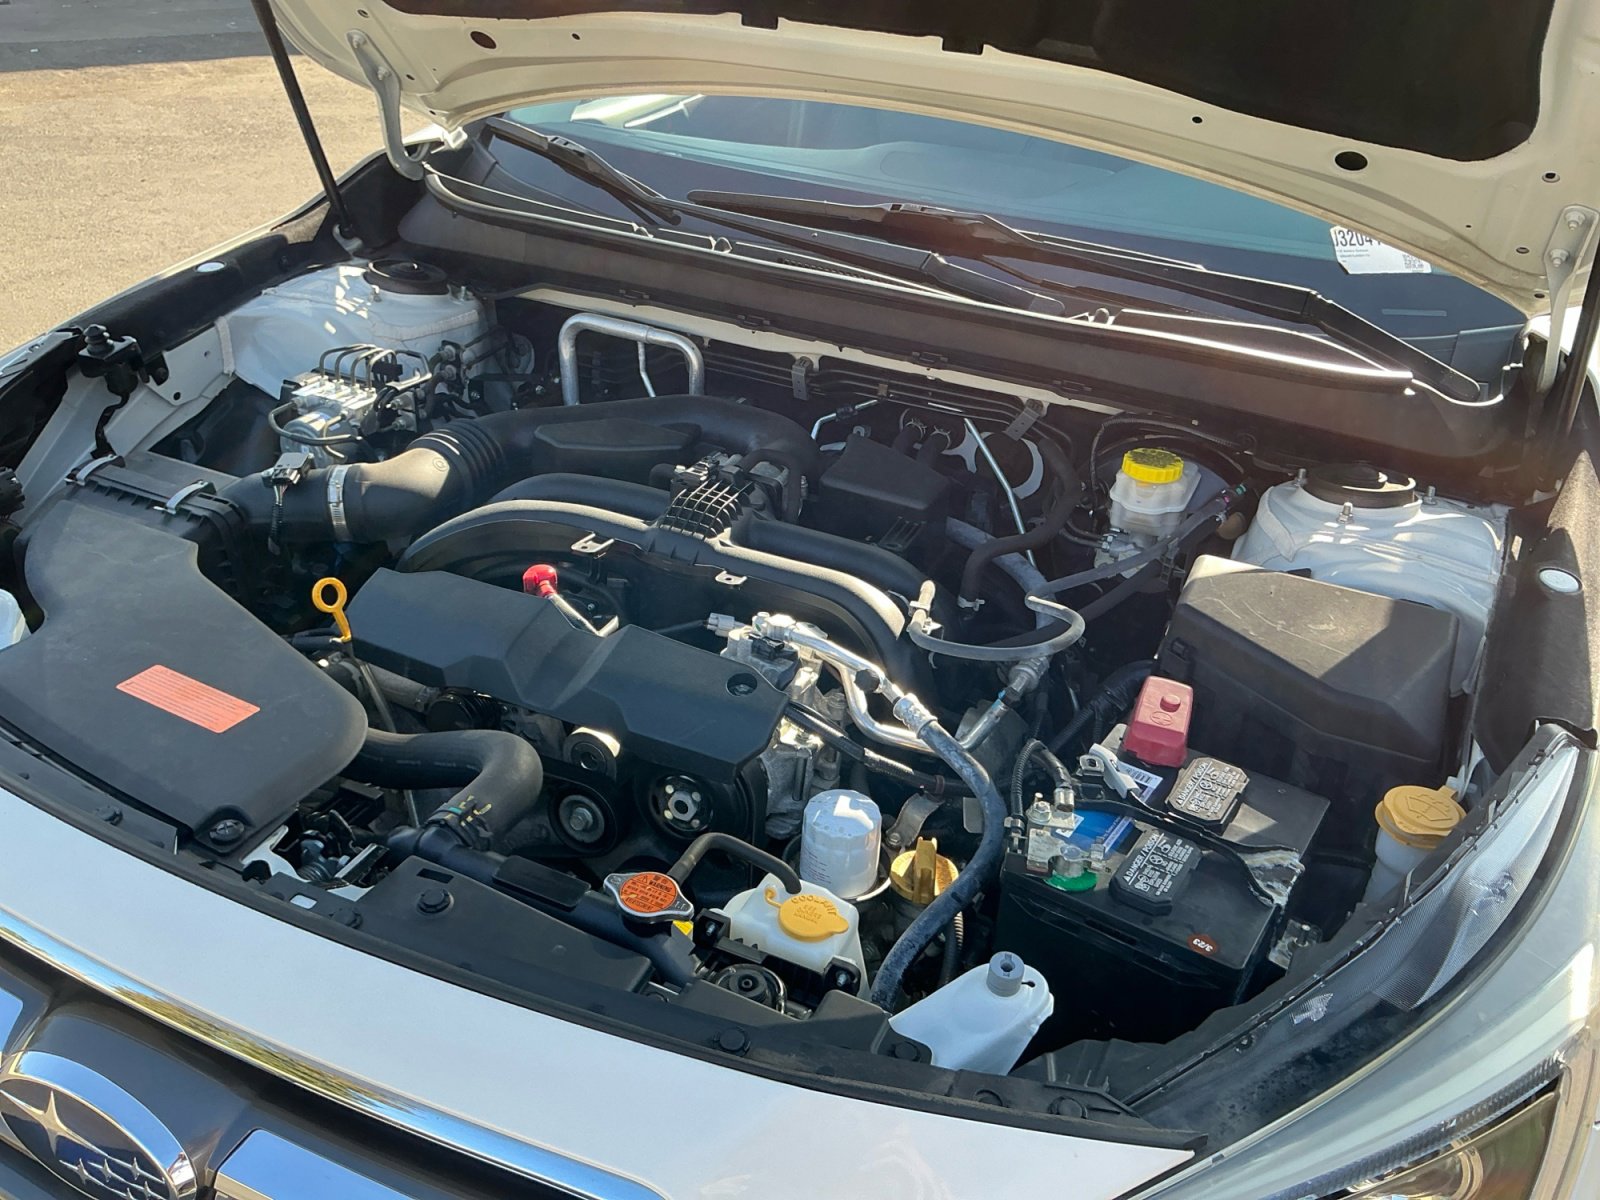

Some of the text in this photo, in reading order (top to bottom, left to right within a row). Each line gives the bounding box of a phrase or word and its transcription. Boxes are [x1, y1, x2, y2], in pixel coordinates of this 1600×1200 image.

[1125, 854, 1145, 877] DANGER
[1142, 833, 1160, 853] POISON
[791, 895, 837, 916] COOLANT
[1192, 938, 1213, 952] 3/23
